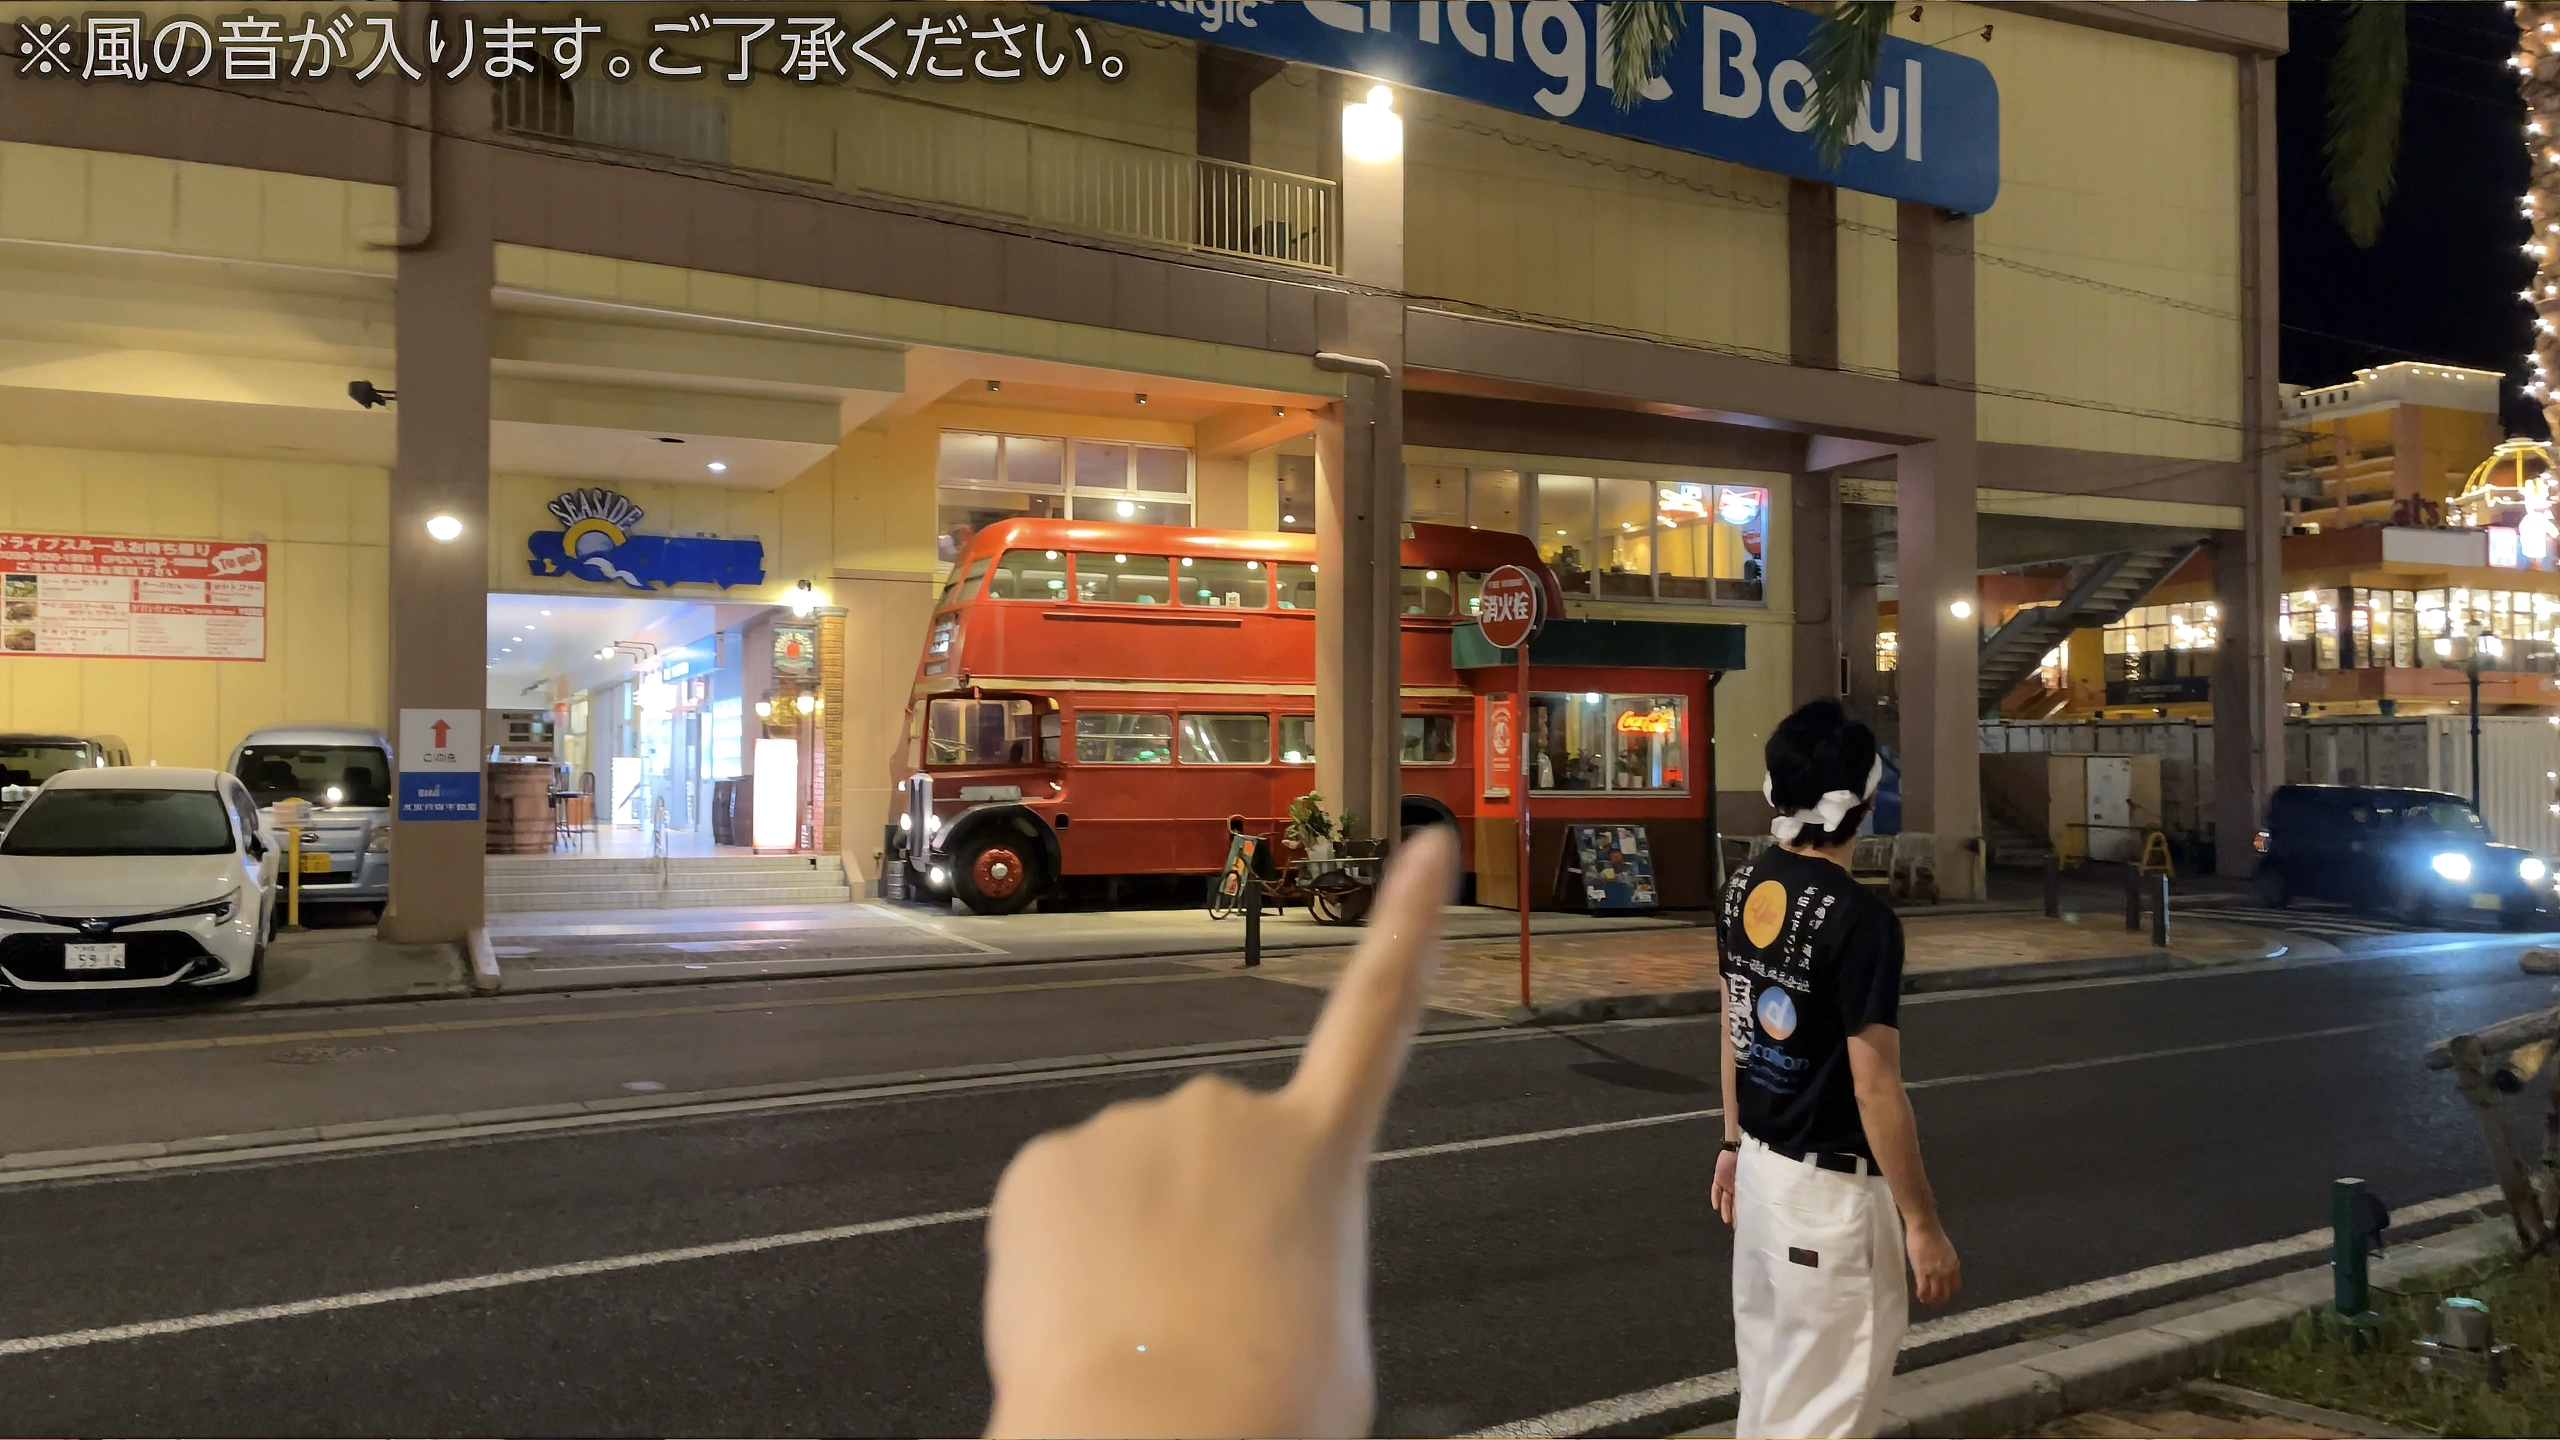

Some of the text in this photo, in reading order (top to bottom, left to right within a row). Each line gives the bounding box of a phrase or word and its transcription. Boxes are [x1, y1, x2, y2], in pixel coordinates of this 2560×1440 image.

[549, 488, 643, 532] SEASIDE
[1483, 591, 1529, 623] 消火栓
